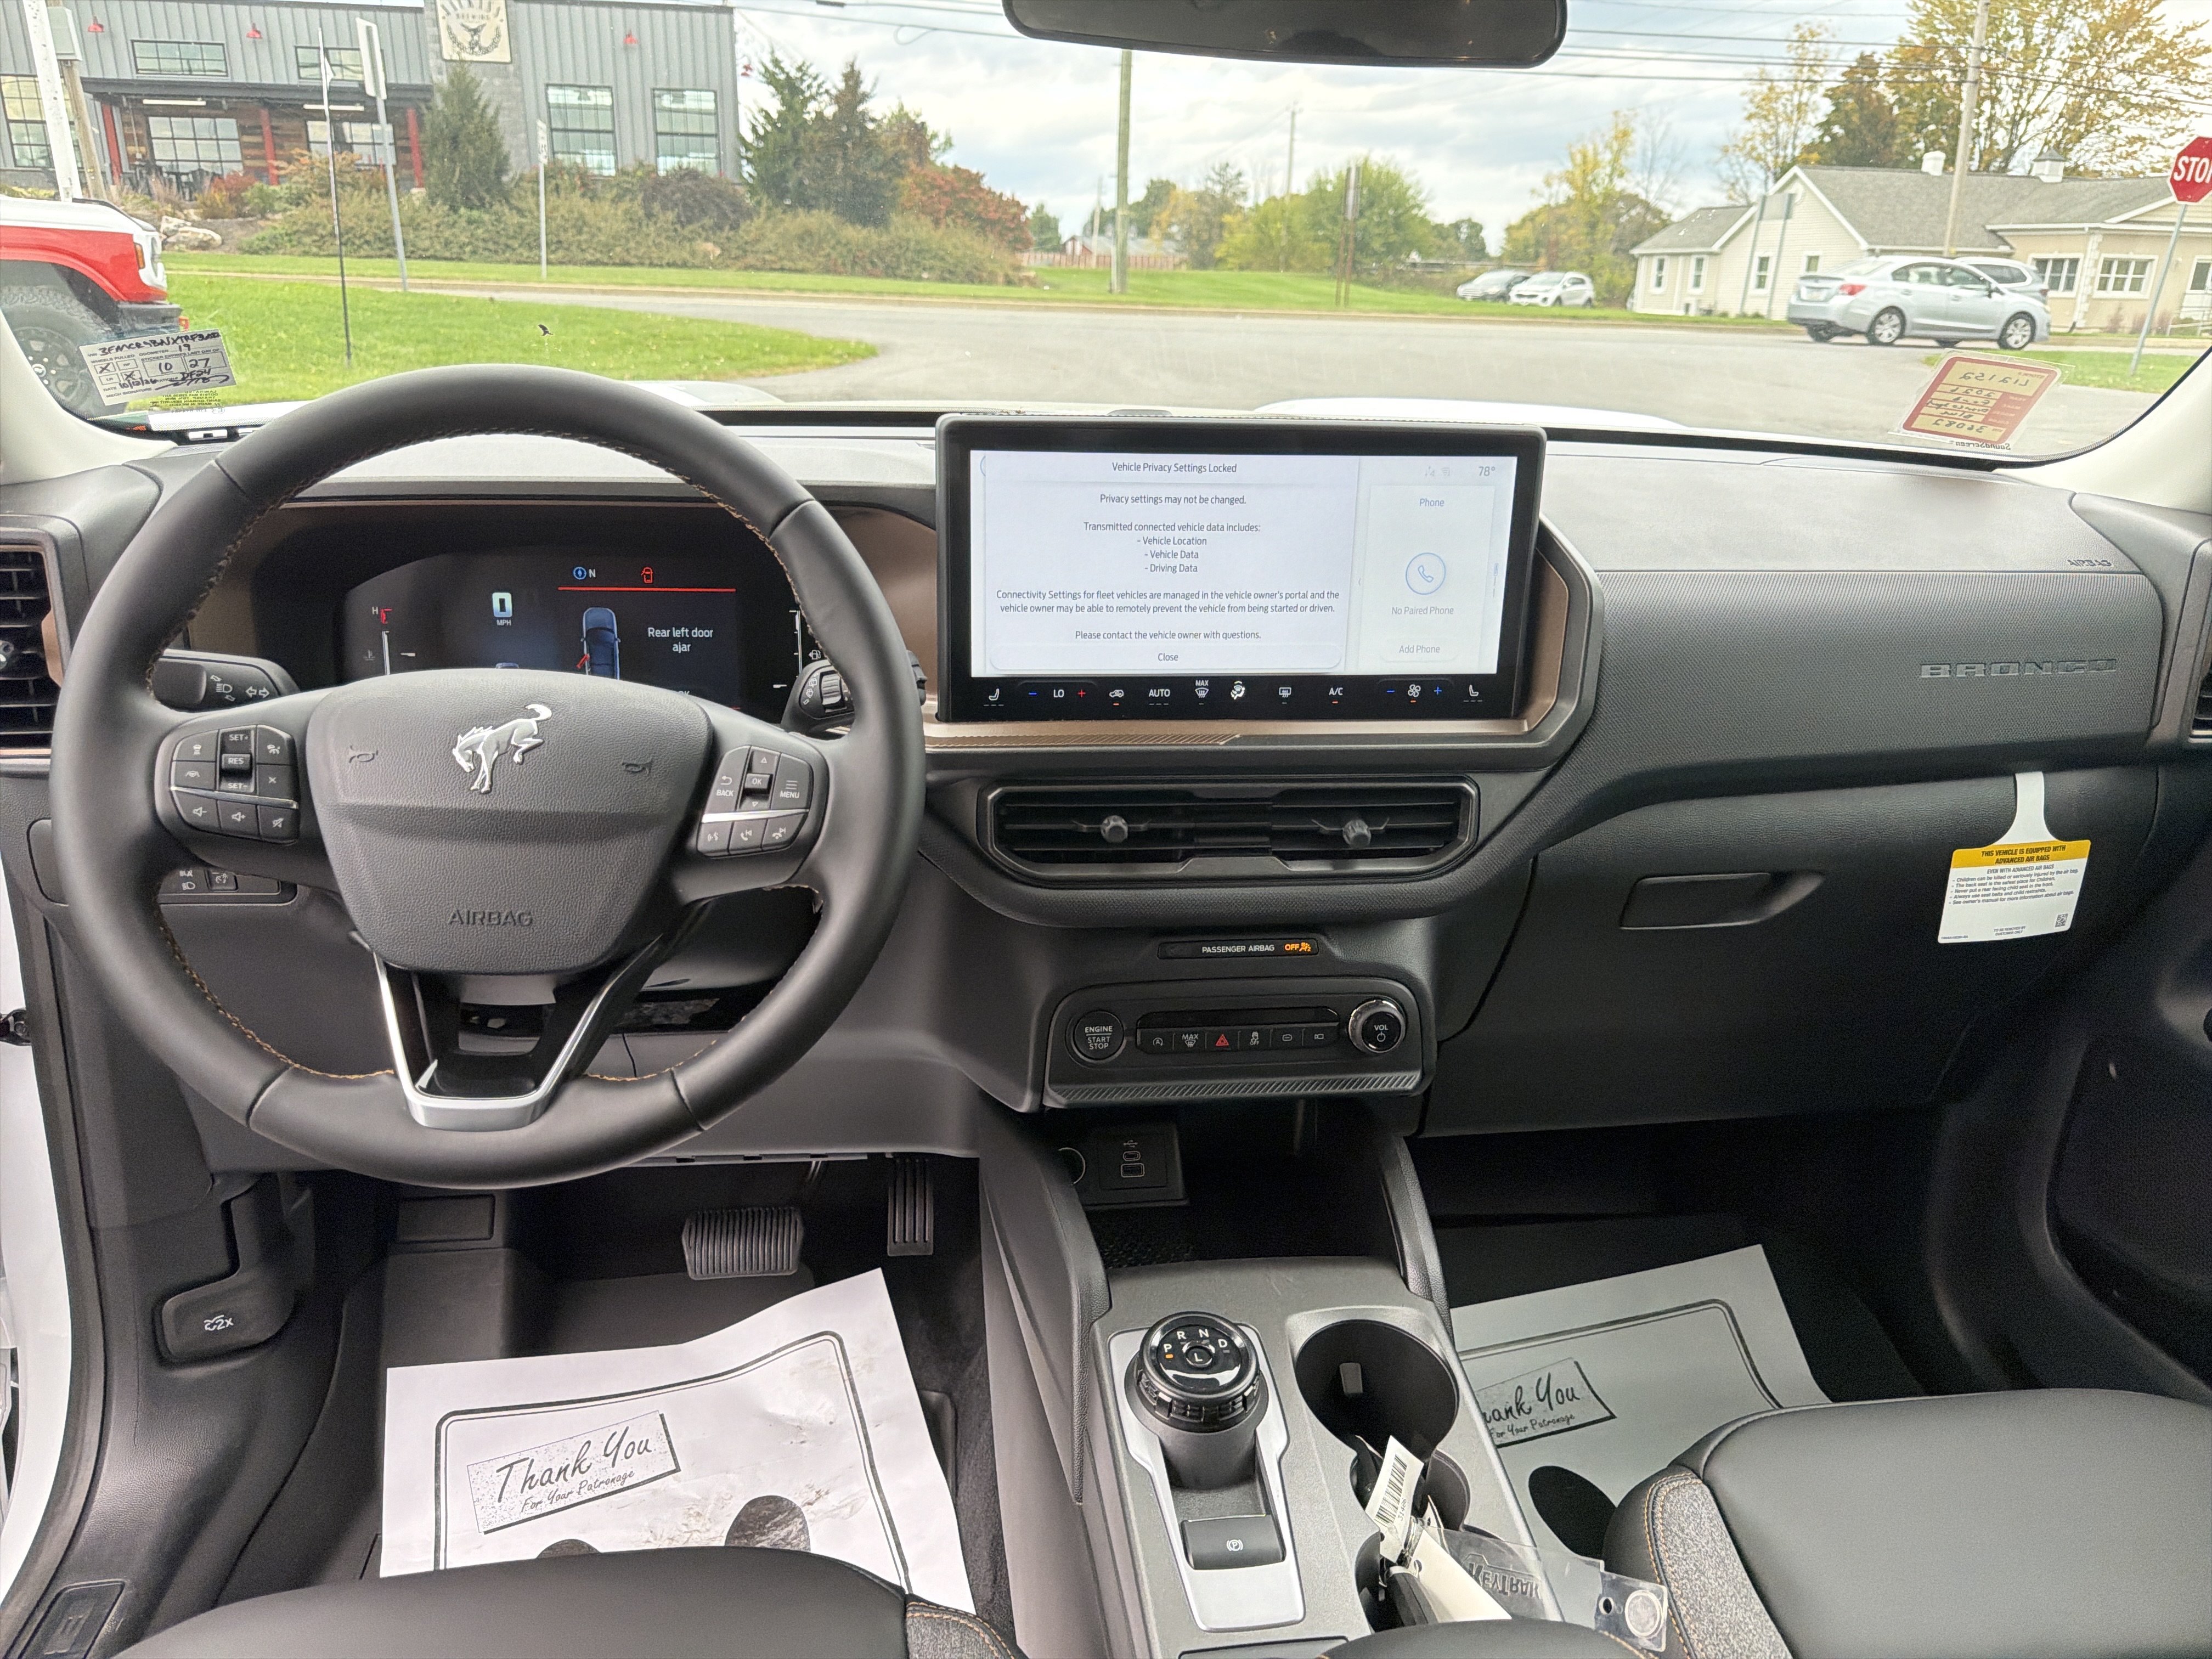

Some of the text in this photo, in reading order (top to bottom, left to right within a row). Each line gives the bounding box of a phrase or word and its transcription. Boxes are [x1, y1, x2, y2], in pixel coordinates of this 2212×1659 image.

[178, 344, 191, 352] 19
[159, 362, 173, 374] 10
[189, 358, 211, 368] 27
[123, 387, 152, 396] SIGNATURE
[1111, 461, 1237, 475] Vehicle Privacy Settings Locked
[1100, 494, 1246, 506] Privacy settings may not be changed.
[1419, 498, 1444, 507] Phone
[1083, 522, 1261, 532] Transmitted connected vehicle data includes:
[1142, 535, 1207, 546] Vehicle Location
[1149, 550, 1199, 559] Vehicle Data
[589, 568, 596, 578] N
[1150, 563, 1198, 574] Driving Data
[996, 590, 1047, 600] Connectivity
[1048, 590, 1082, 600] Settings
[1083, 590, 1095, 599] for
[1096, 590, 1115, 599] fleet
[1116, 590, 1148, 600] vehicles
[1163, 590, 1200, 600] managed
[1201, 591, 1209, 600] in
[1210, 590, 1223, 600] the
[1224, 590, 1252, 600] vehicle
[1253, 590, 1284, 599] owner's
[1284, 590, 1308, 600] portal
[1310, 590, 1325, 599] and
[1327, 590, 1340, 599] the
[492, 592, 513, 618] 0
[1000, 603, 1028, 612] vehicle
[1056, 606, 1074, 614] may
[1075, 603, 1085, 613] be
[1086, 603, 1104, 613] able
[1105, 604, 1114, 613] to
[1116, 603, 1152, 614] remotely
[1153, 604, 1183, 614] prevent
[1184, 603, 1198, 613] the
[1198, 603, 1226, 613] vehicle
[1227, 603, 1246, 613] from
[1247, 603, 1269, 614] being
[1270, 603, 1299, 613] started
[1309, 603, 1335, 612] driven.
[1391, 606, 1454, 615] No Paired Phone
[647, 627, 714, 638] Rear left door
[1075, 630, 1101, 639] Please
[1102, 631, 1133, 639] contact
[1134, 630, 1148, 639] the
[1149, 630, 1176, 639] vehicle
[1203, 630, 1221, 639] with
[1222, 630, 1261, 640] questions.
[672, 641, 691, 653] ajar
[1398, 645, 1441, 653] Add Phone
[1158, 652, 1178, 662] Close
[1920, 658, 2117, 678] BRONCO
[1053, 689, 1064, 698] LO
[1148, 689, 1170, 698] AUTO
[1329, 687, 1344, 696] A/C
[752, 777, 762, 786] OK
[716, 789, 735, 797] BACK
[780, 791, 800, 799] MENU
[447, 909, 533, 926] AIRBAG
[1202, 945, 1246, 953] PASSENGER
[1176, 1331, 1187, 1340] R
[1198, 1329, 1209, 1338] N
[1163, 1344, 1172, 1353] P
[1218, 1339, 1228, 1348] D
[1194, 1352, 1203, 1362] L
[1536, 1372, 1581, 1411] You
[1507, 1423, 1529, 1436] Your
[1530, 1414, 1576, 1430] Patronage
[495, 1426, 652, 1503] Thank You
[521, 1470, 635, 1513] For Your Patronage
